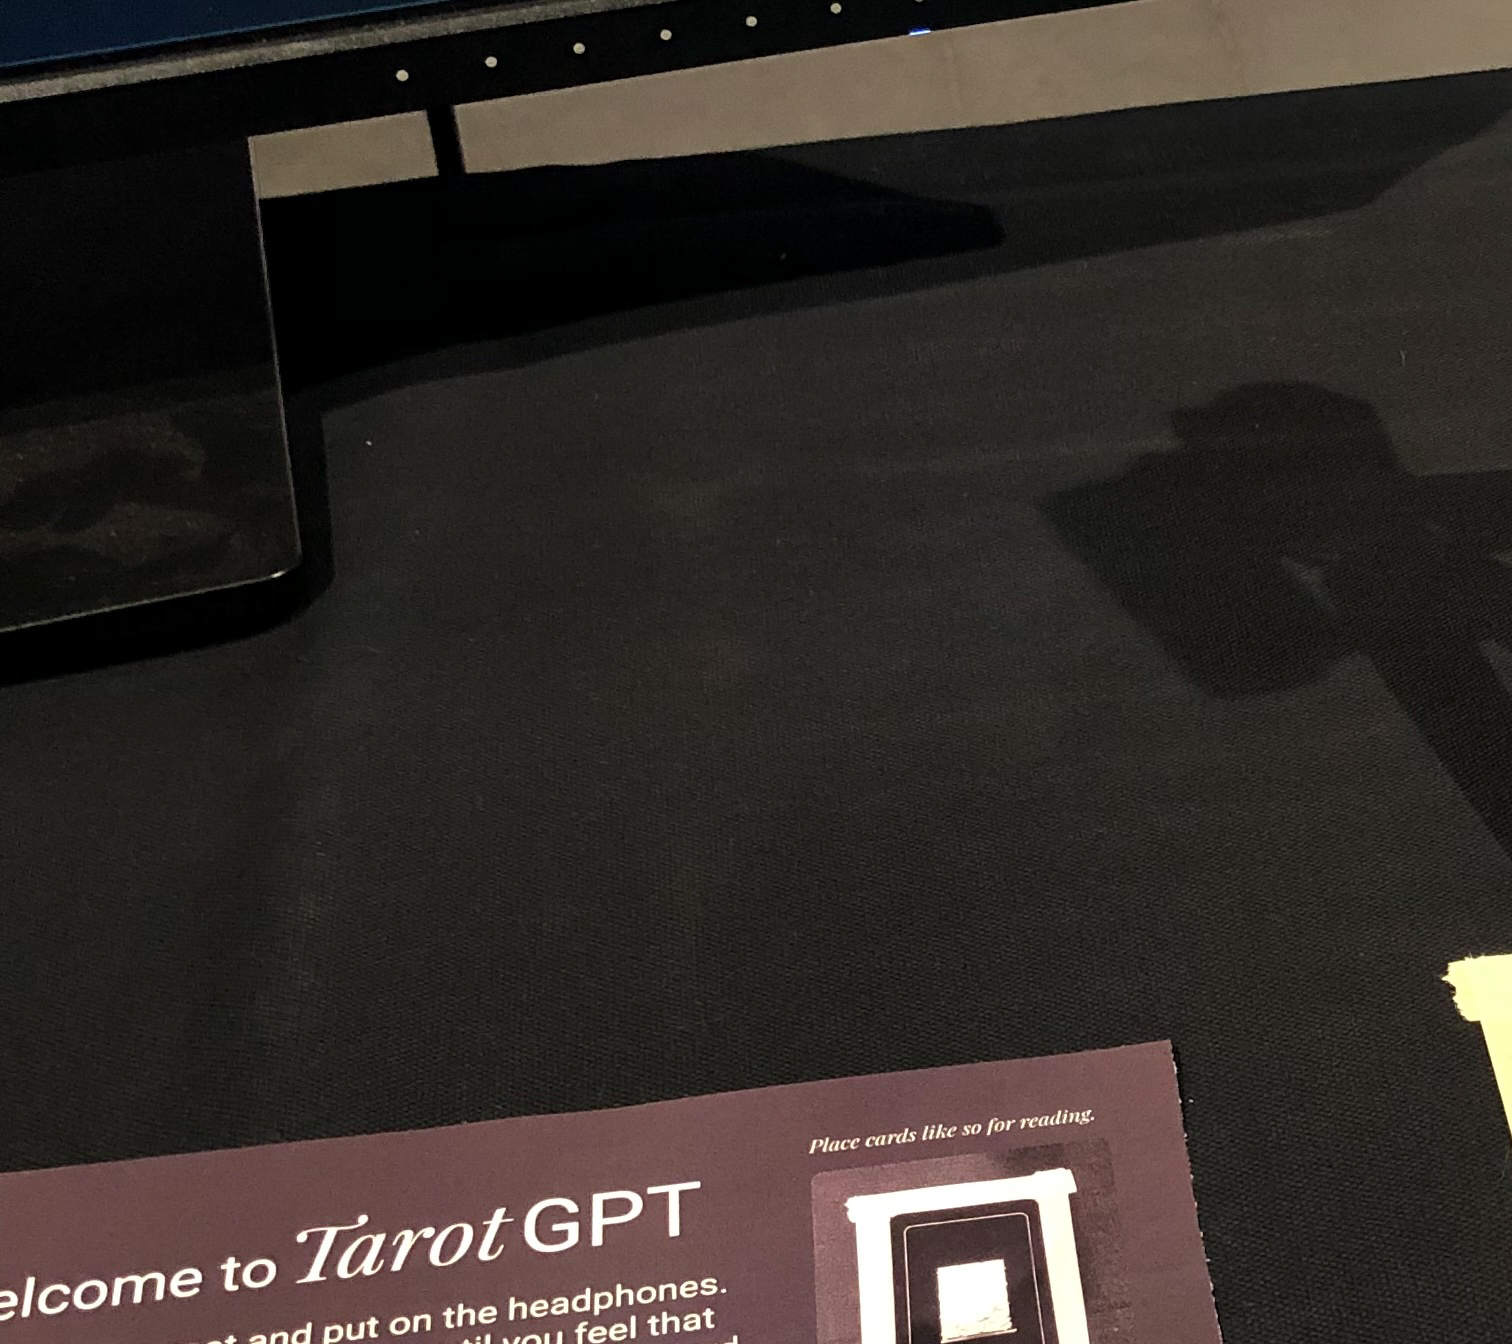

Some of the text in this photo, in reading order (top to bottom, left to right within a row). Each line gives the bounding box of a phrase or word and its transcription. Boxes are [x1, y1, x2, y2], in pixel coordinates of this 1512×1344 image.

[809, 1109, 1095, 1154] Place cards like so for reading.
[221, 1257, 276, 1291] to
[389, 1313, 432, 1336] on
[442, 1302, 498, 1329] the
[508, 1277, 727, 1321] headphones.
[646, 1307, 715, 1337] that
